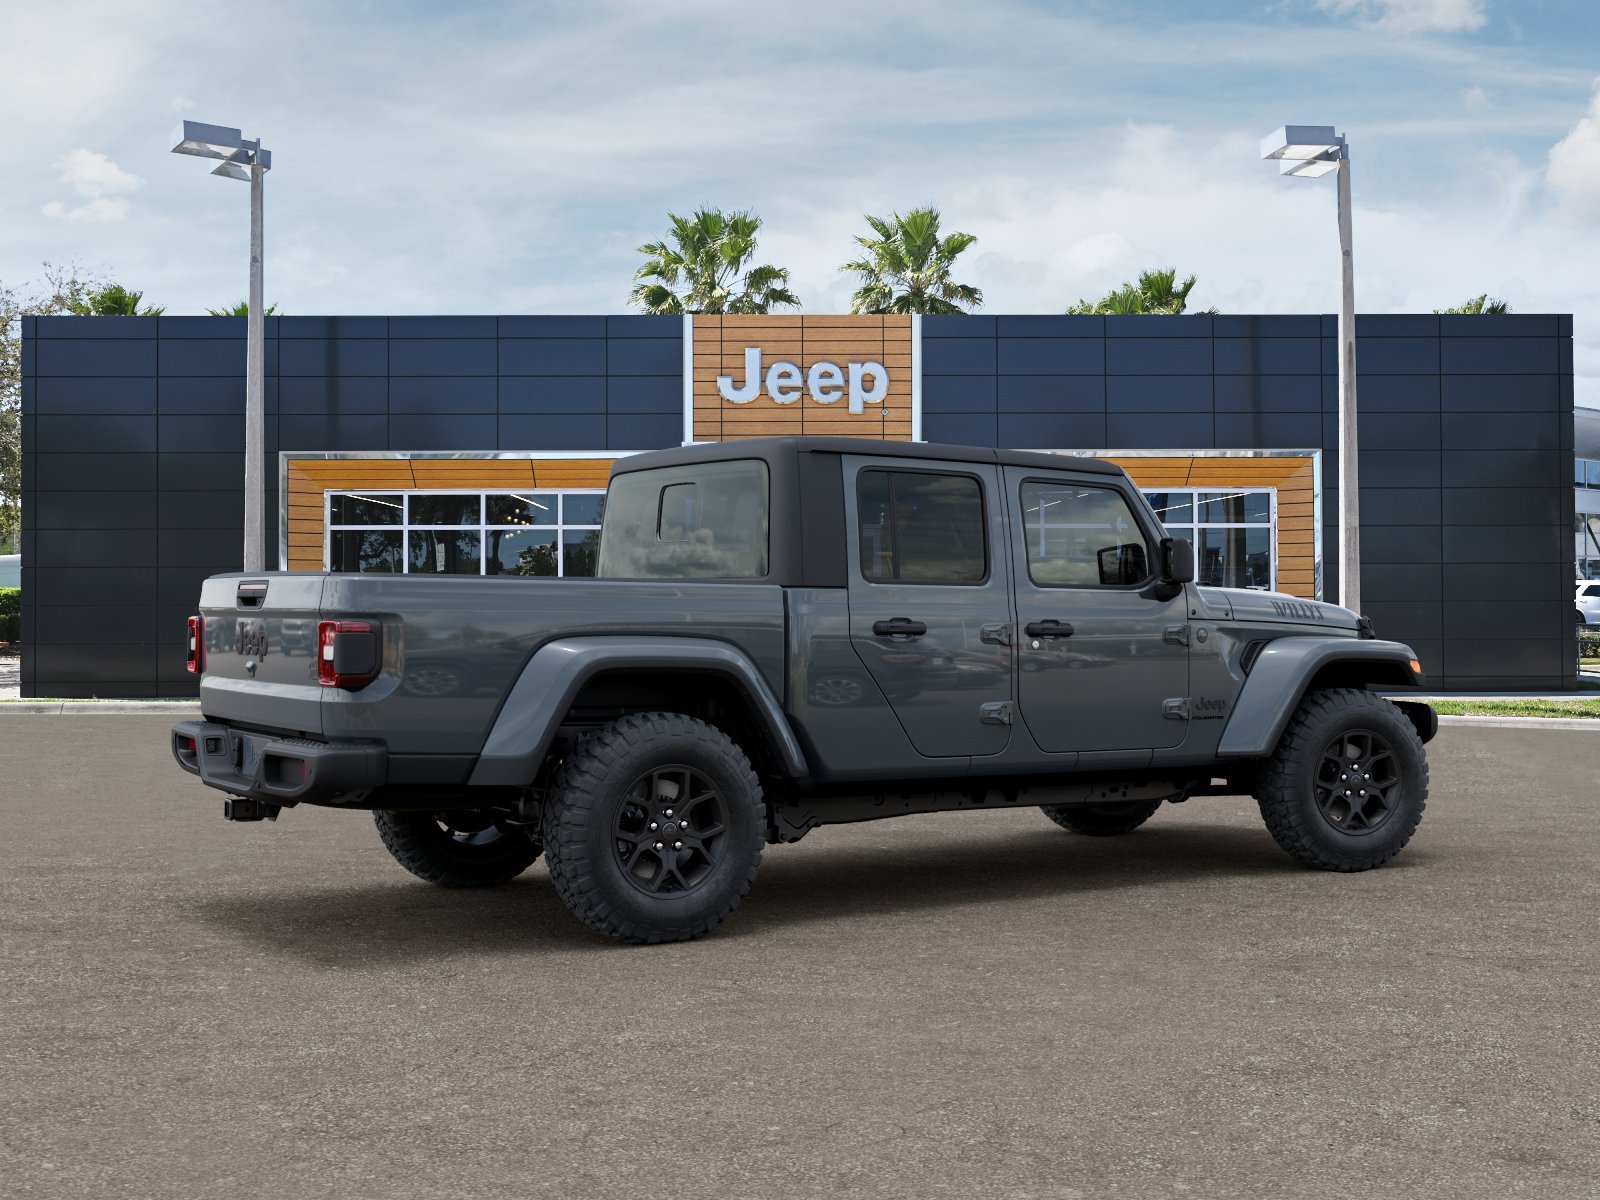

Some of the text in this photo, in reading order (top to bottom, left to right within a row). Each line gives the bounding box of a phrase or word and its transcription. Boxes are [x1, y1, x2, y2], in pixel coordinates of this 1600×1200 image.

[717, 347, 889, 414] Jeep
[1271, 600, 1324, 620] WILLYS
[236, 622, 268, 662] Jeep
[1196, 696, 1226, 712] Jeep
